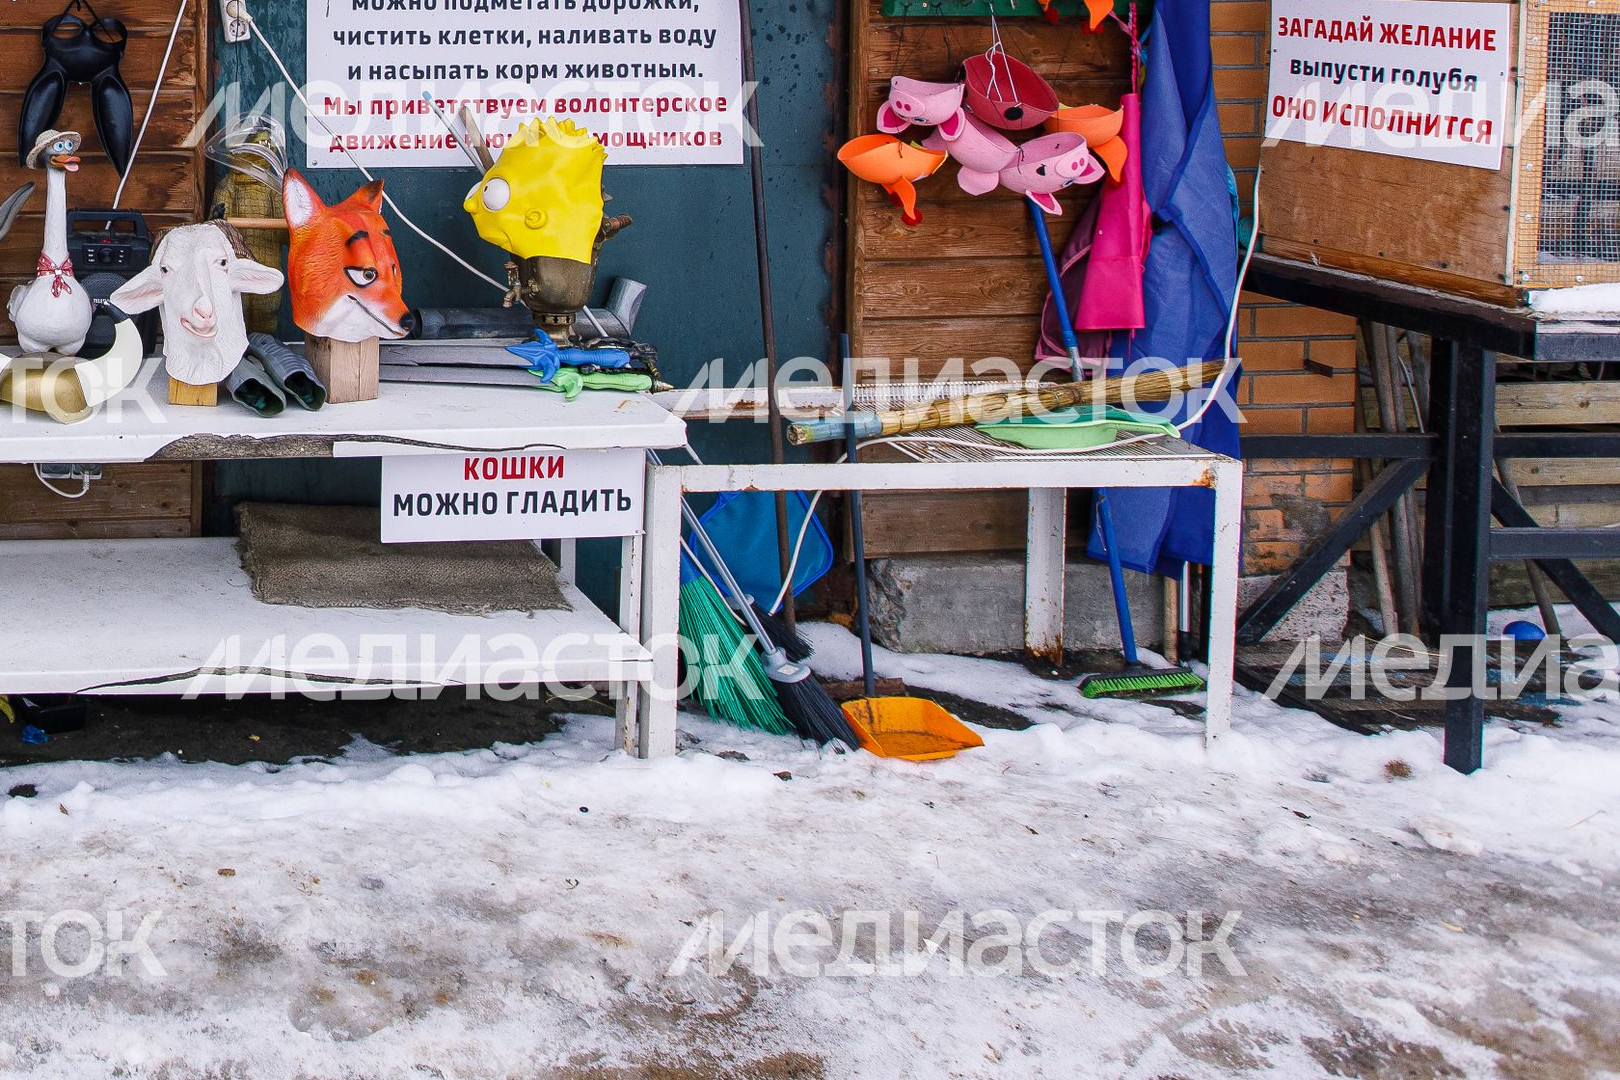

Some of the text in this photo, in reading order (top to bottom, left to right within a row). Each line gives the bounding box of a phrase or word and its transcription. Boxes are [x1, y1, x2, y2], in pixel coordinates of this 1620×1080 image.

[333, 29, 717, 49] чистить клетки, наливать воду
[1278, 15, 1497, 52] ЗАГАДАЙ ЖЕЛАНИЕ
[348, 63, 704, 85] и насыпать корм животным.
[1289, 59, 1478, 94] выпусти голубя
[323, 96, 728, 121] Мы приветствуем волонтерское
[1272, 95, 1494, 145] ОНО ИСПОЛНИТСЯ
[329, 133, 458, 153] движение
[592, 130, 723, 153] мощников
[463, 456, 565, 482] КОШКИ
[393, 488, 632, 518] МОЖНО ГЛАДИТЬ
